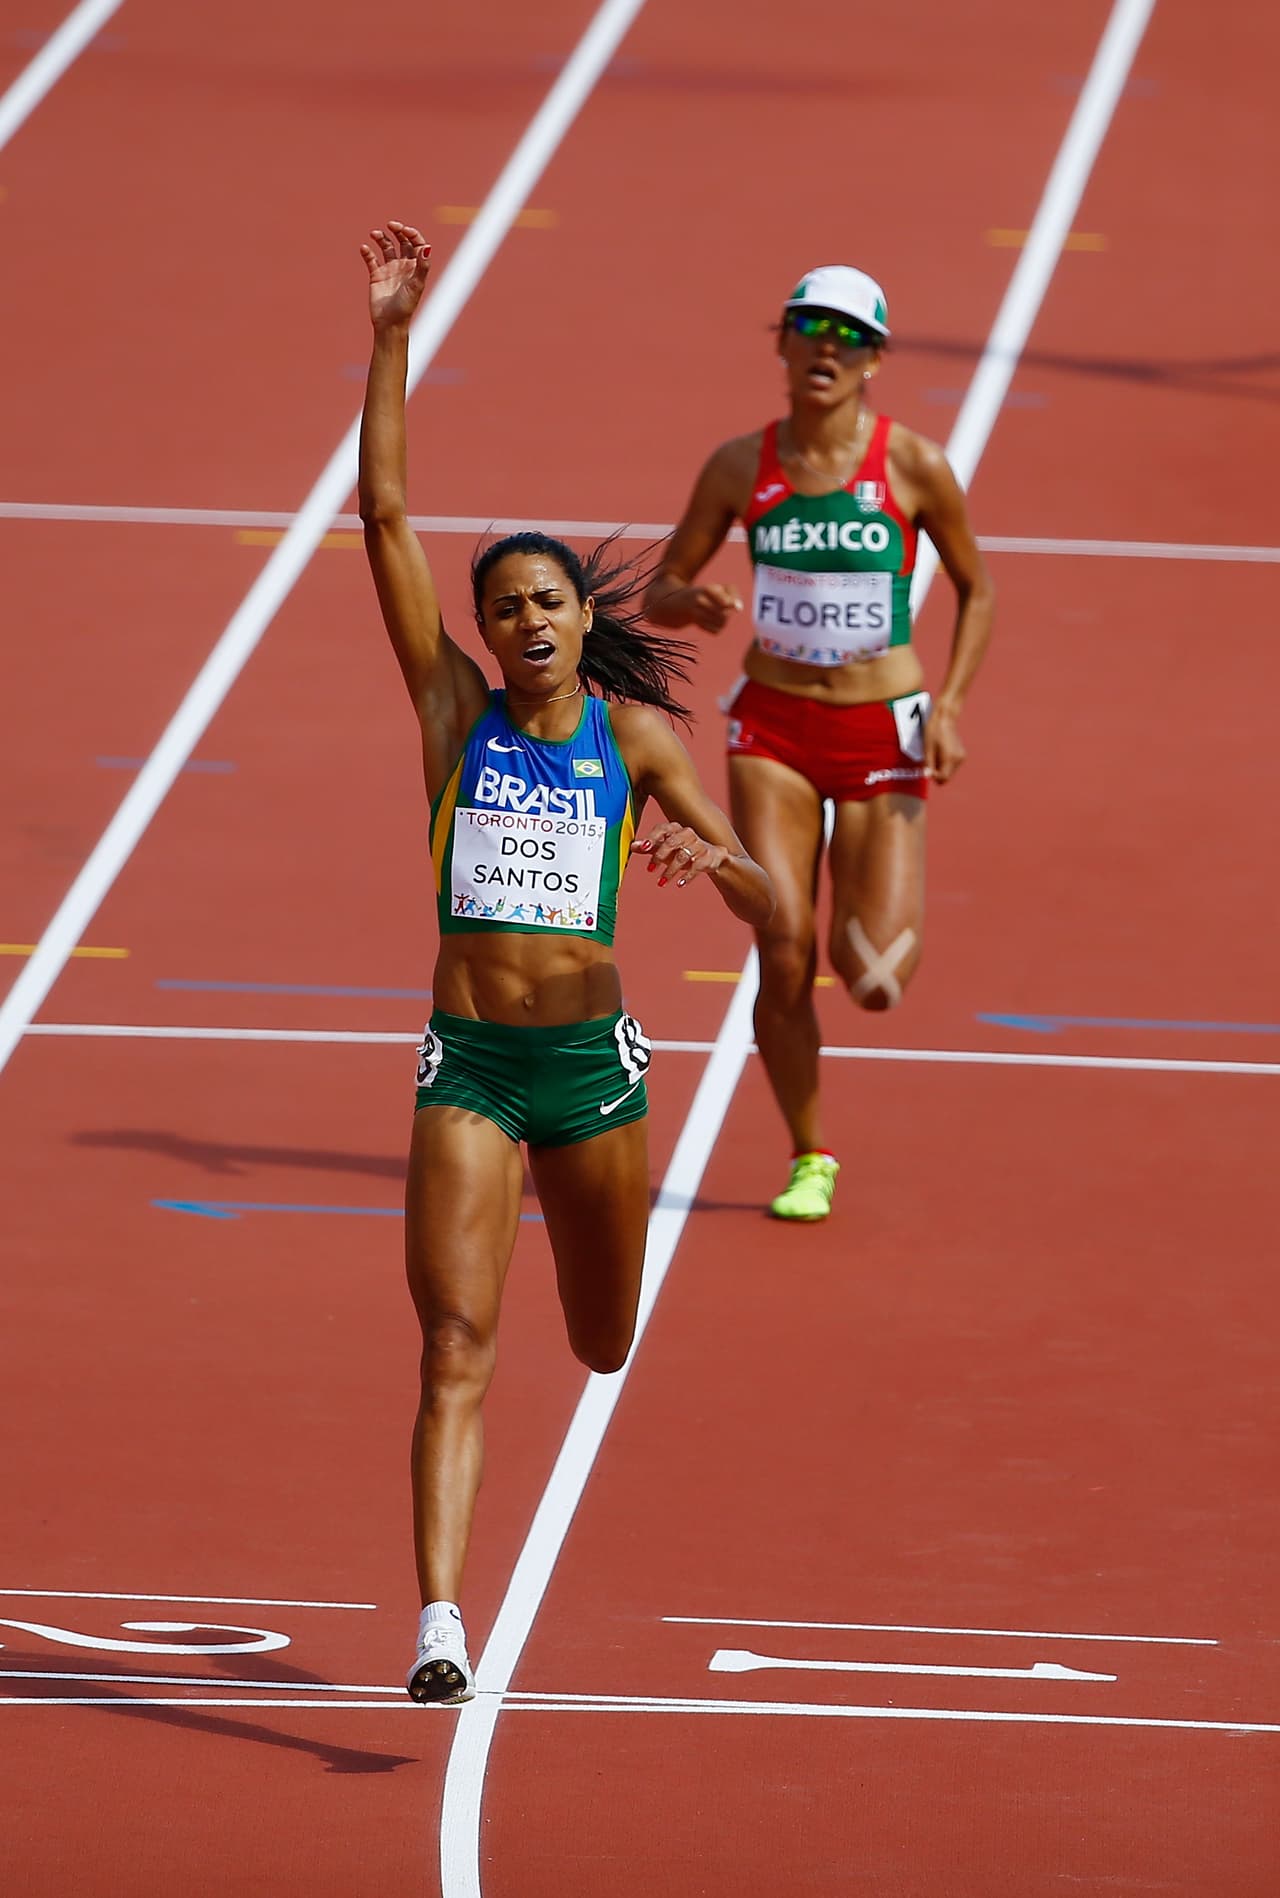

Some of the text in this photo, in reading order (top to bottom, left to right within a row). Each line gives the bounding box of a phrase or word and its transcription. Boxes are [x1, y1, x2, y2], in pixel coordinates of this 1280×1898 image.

[755, 518, 890, 553] MÉXICO
[759, 594, 885, 628] FLORES
[474, 766, 606, 822] BRASIL
[500, 836, 556, 861] DOS
[473, 864, 579, 894] SANTOS
